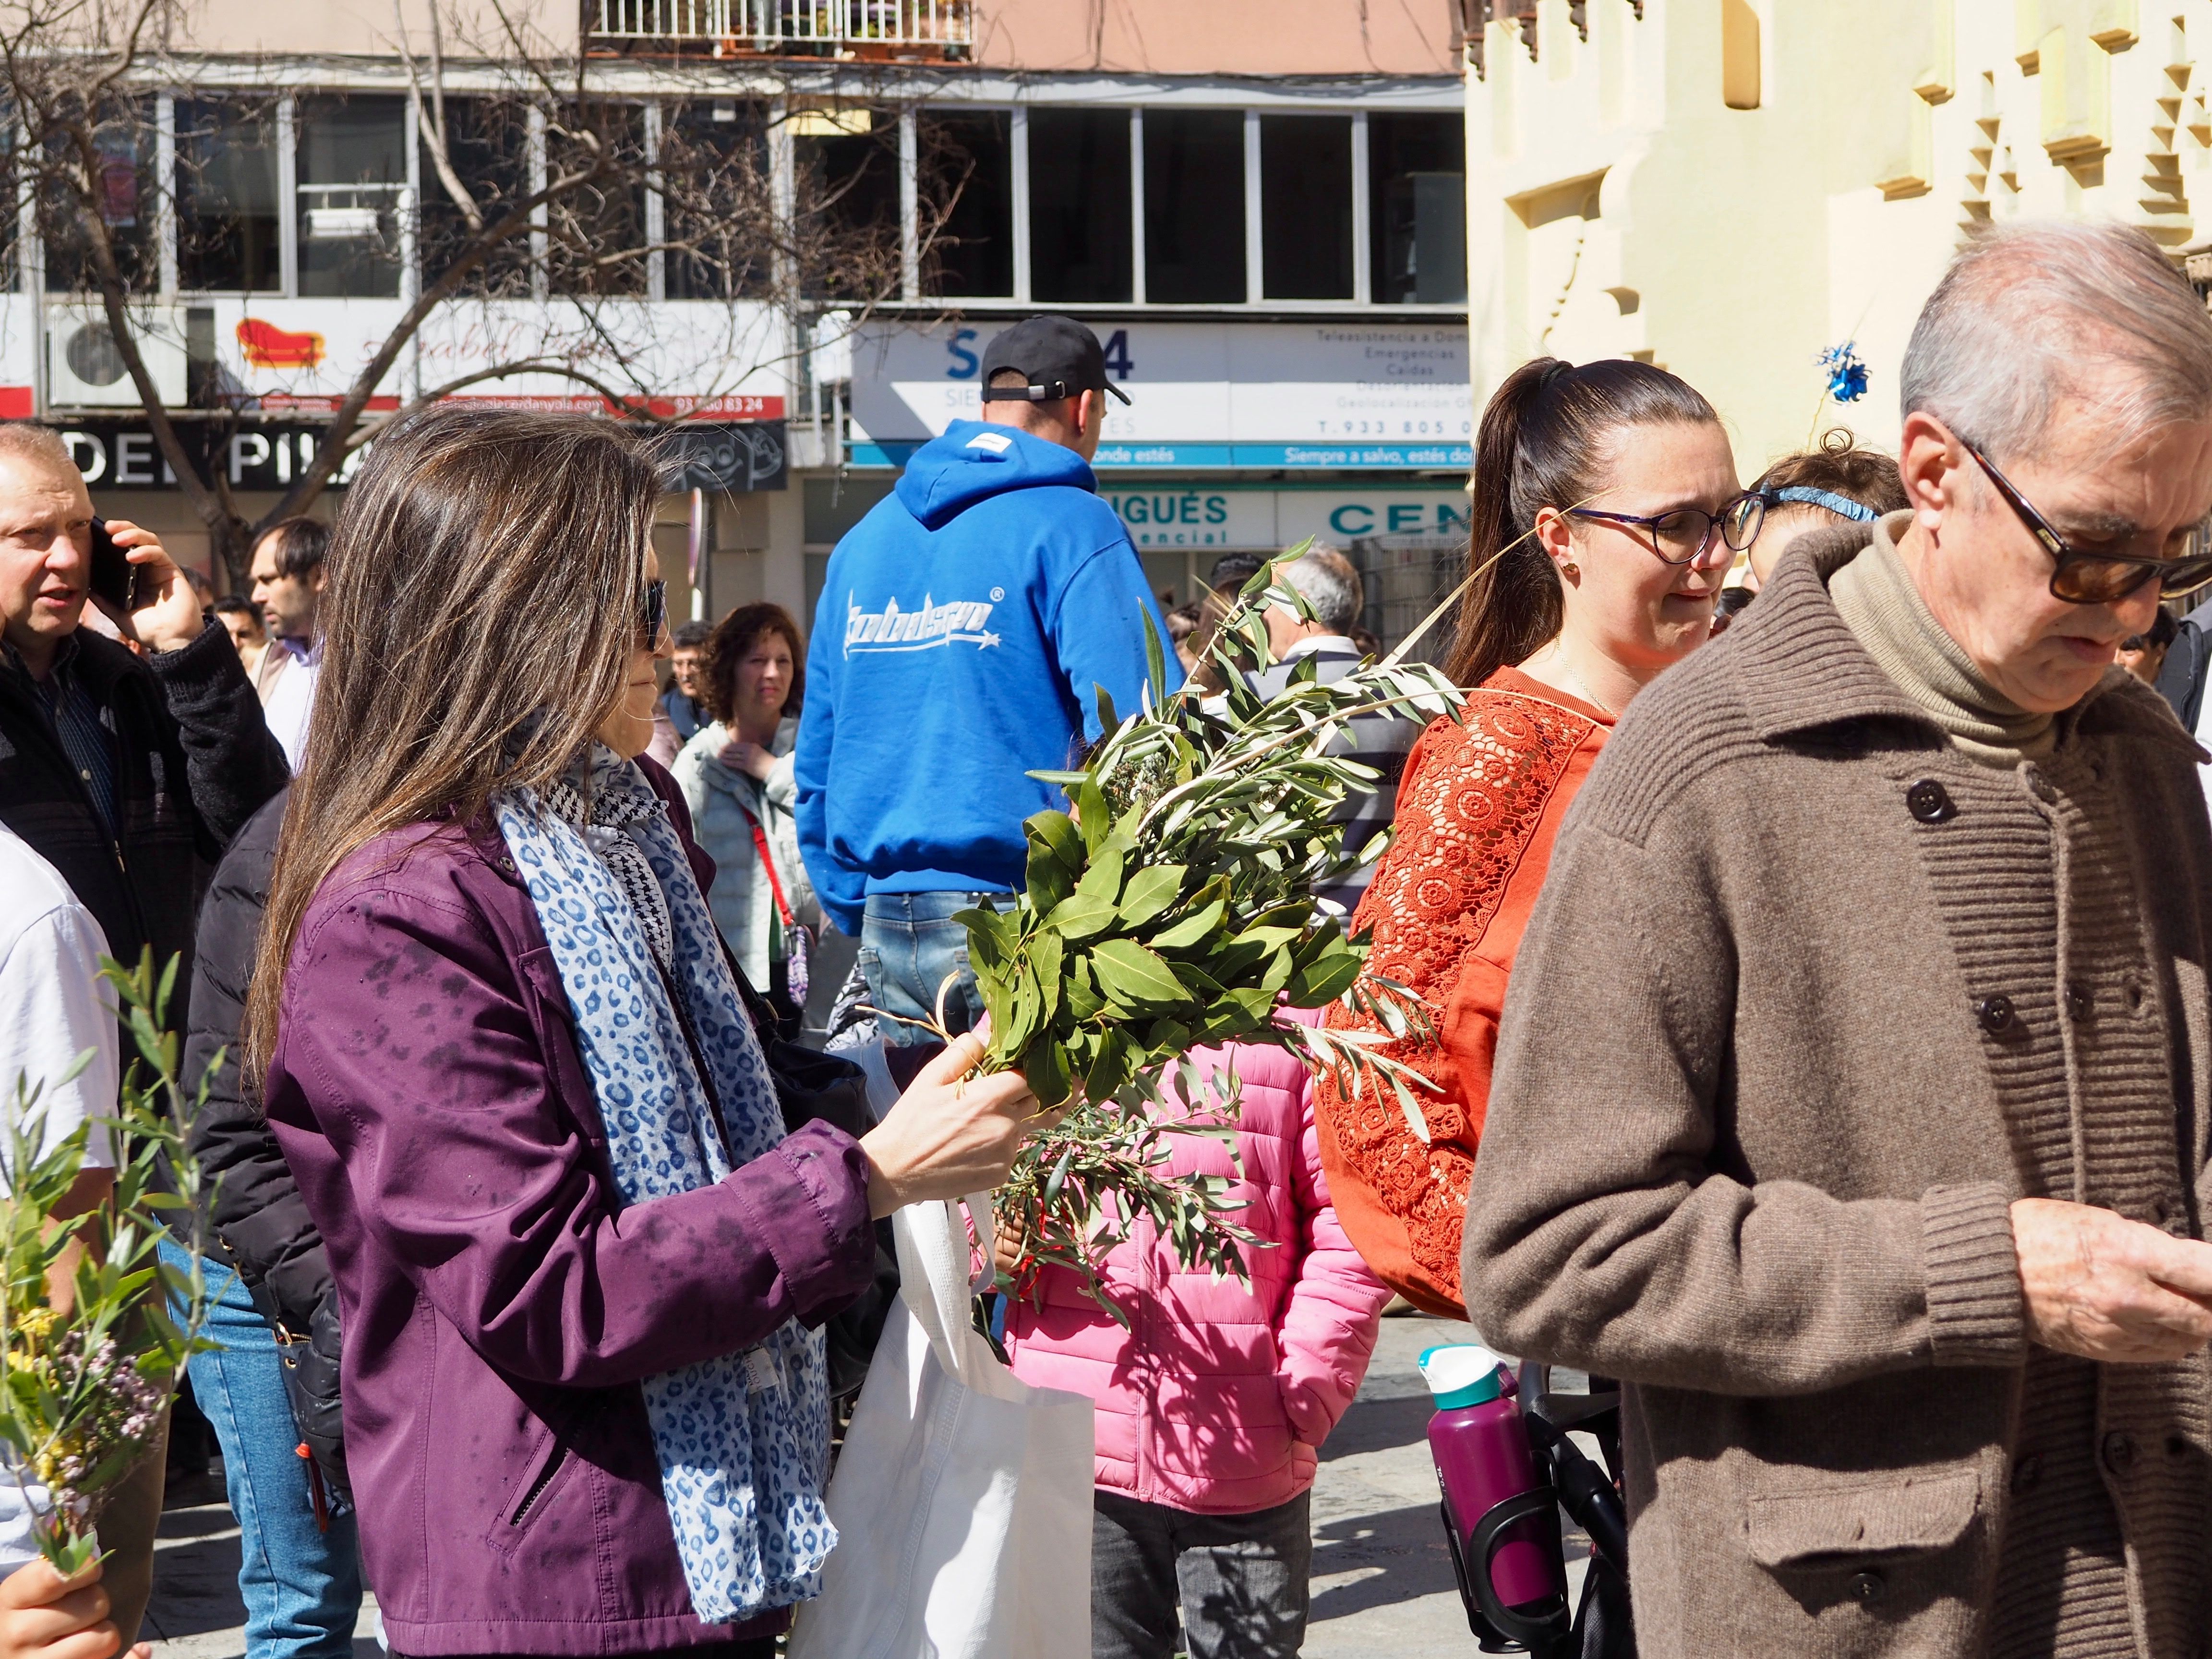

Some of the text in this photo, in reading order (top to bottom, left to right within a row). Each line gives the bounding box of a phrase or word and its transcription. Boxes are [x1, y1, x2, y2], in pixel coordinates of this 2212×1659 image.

[1364, 346, 1455, 361] Emergencias
[744, 397, 764, 413] 24
[1403, 421, 1443, 433] 805
[61, 432, 178, 484] DE
[1092, 446, 1176, 462] onde estés
[1285, 446, 1346, 465] Siempre
[1349, 451, 1360, 463] a
[1363, 447, 1405, 465] salvo,
[1407, 447, 1447, 462] estés
[1141, 530, 1227, 544] encial
